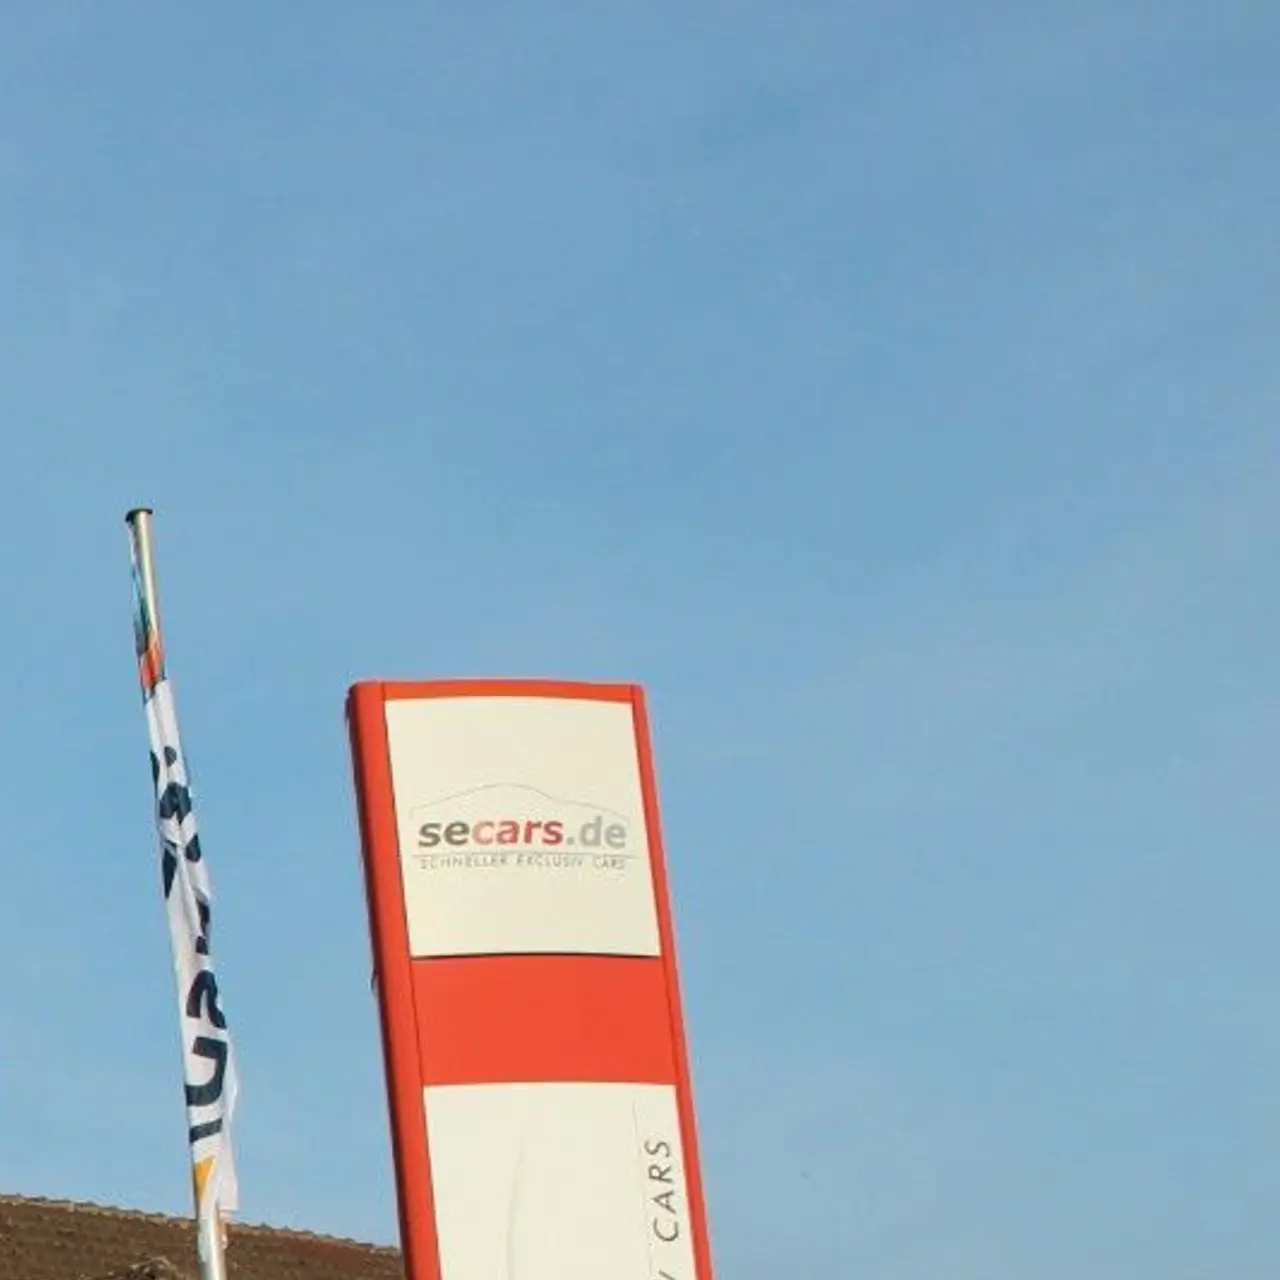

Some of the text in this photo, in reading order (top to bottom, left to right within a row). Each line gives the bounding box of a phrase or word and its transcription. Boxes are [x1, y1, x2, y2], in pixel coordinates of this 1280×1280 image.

[418, 816, 628, 850] secars.de
[420, 854, 509, 870] SCHNELLER
[644, 1138, 680, 1243] CARS
